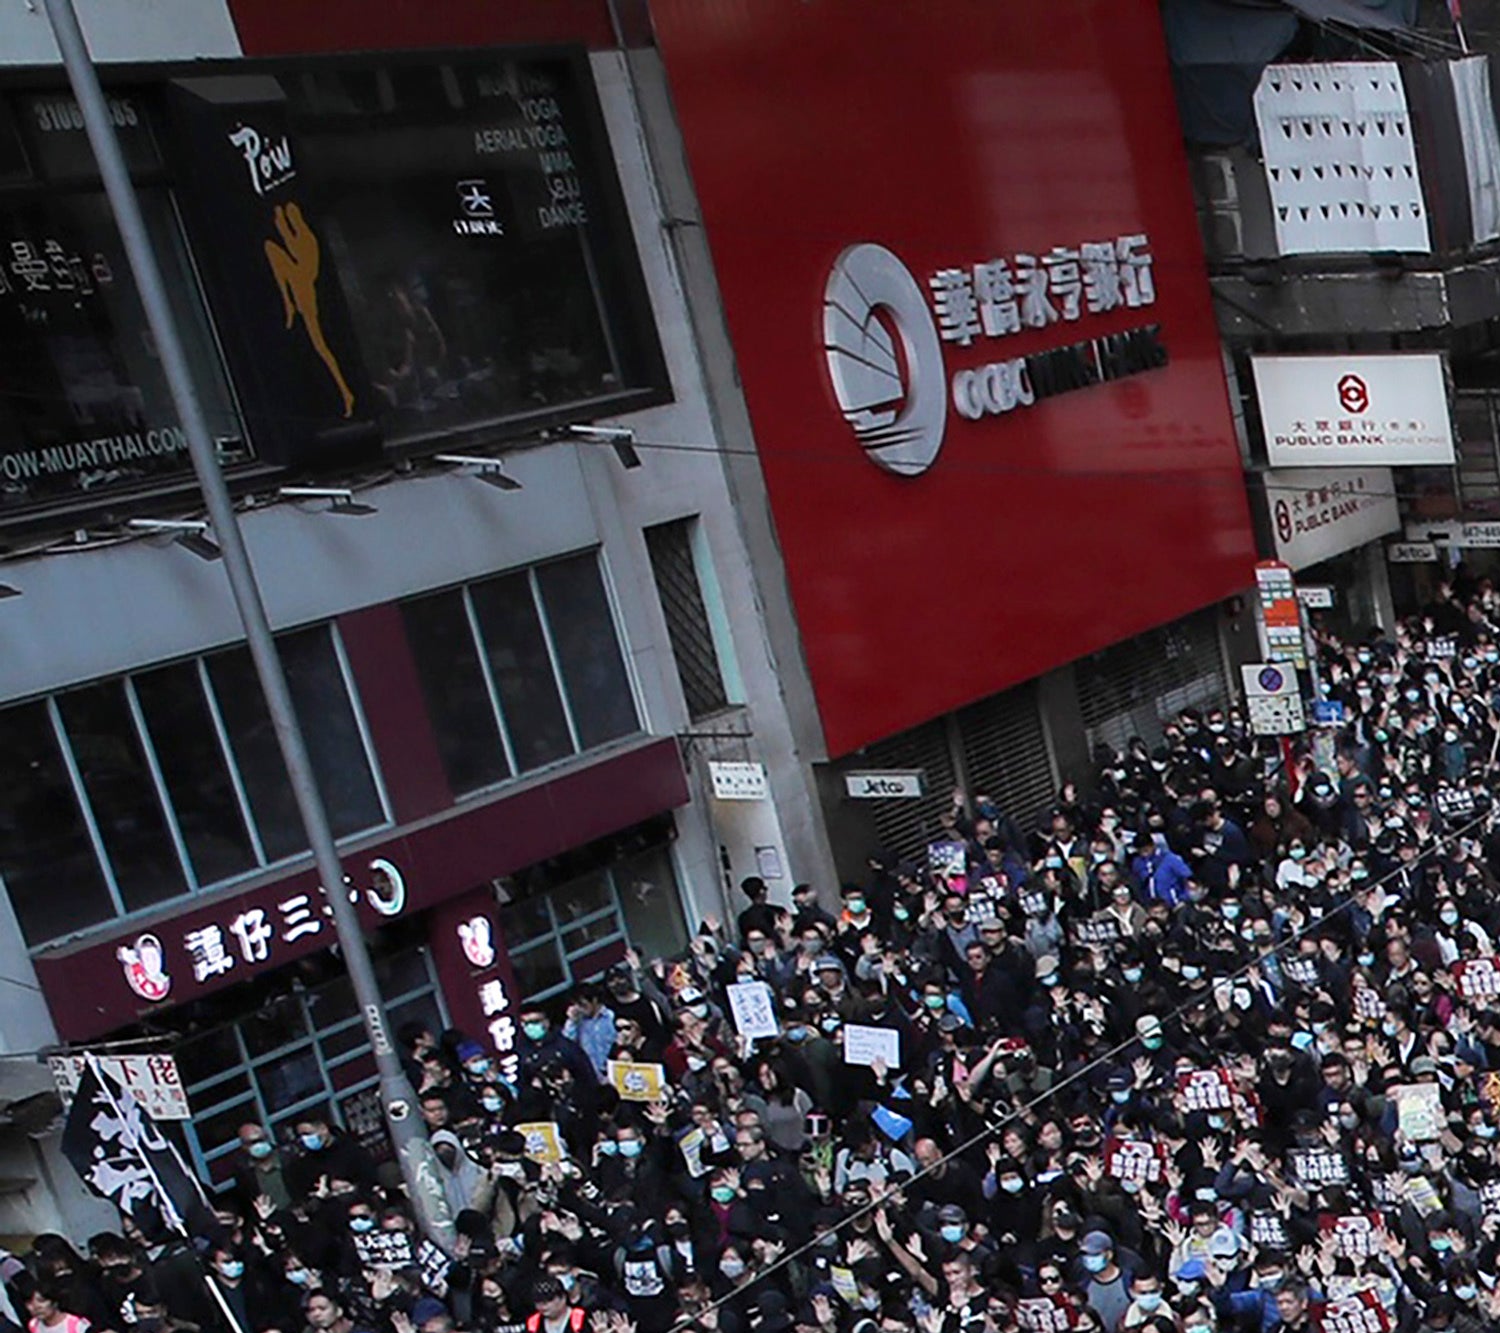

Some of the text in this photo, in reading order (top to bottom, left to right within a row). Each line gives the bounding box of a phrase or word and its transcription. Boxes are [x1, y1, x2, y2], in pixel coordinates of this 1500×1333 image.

[521, 98, 560, 121] YOGA
[474, 127, 567, 153] AERIAL YOGA
[538, 206, 588, 229] DANCE
[930, 234, 1156, 346] 華僑永亨銀行
[953, 358, 1035, 420] OCBC
[1275, 433, 1384, 446] PUBLIC BANK
